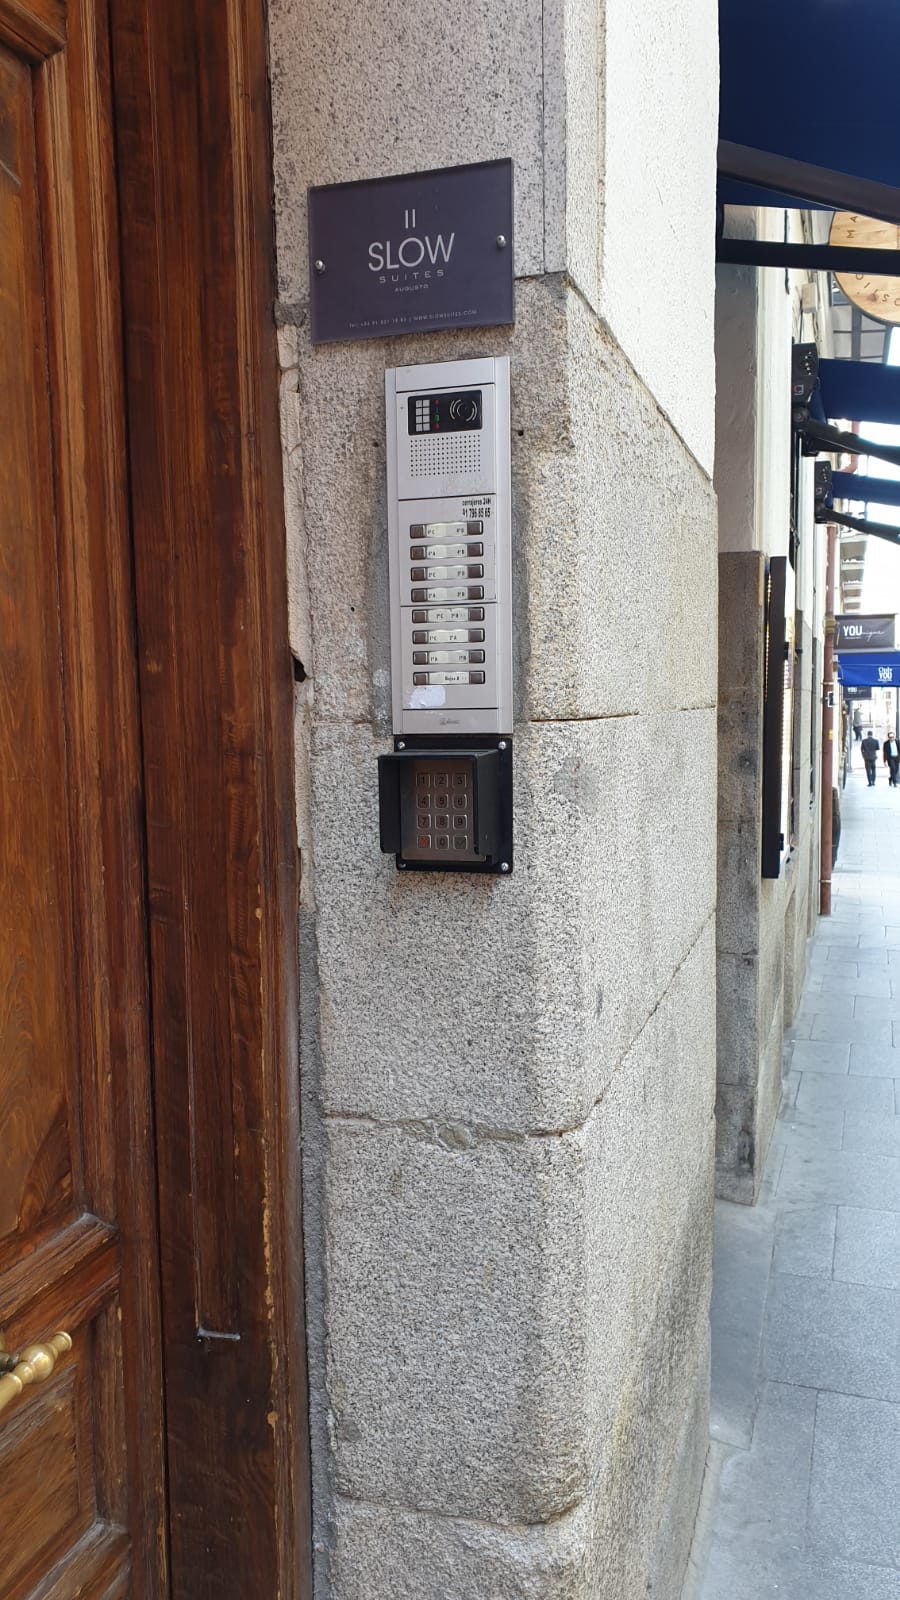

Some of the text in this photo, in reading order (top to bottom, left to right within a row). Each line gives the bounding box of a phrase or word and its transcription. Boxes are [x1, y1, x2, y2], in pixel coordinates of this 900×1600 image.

[368, 232, 455, 272] SLOW
[379, 269, 445, 284] SUITES
[394, 283, 429, 293] AUGUSTO
